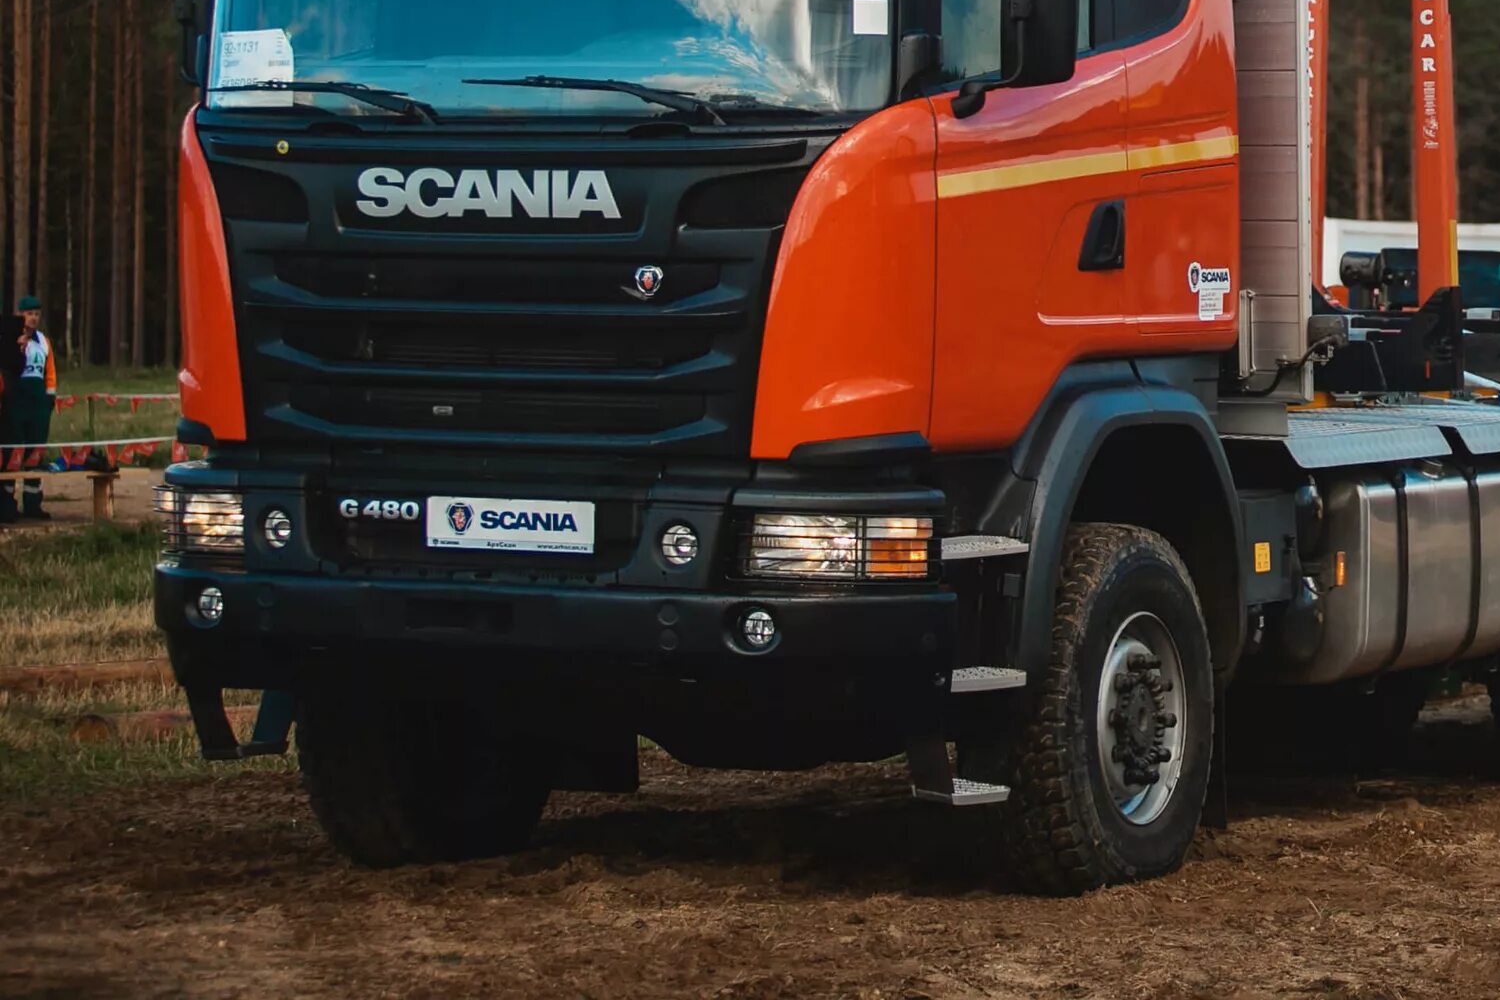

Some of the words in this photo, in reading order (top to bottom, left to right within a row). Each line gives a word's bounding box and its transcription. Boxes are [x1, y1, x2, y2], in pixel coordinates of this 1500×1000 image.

[356, 167, 621, 220] SCANIA
[1202, 272, 1228, 282] SCANIA
[340, 498, 359, 518] G
[363, 500, 420, 521] 480
[480, 510, 578, 532] SCANIA
